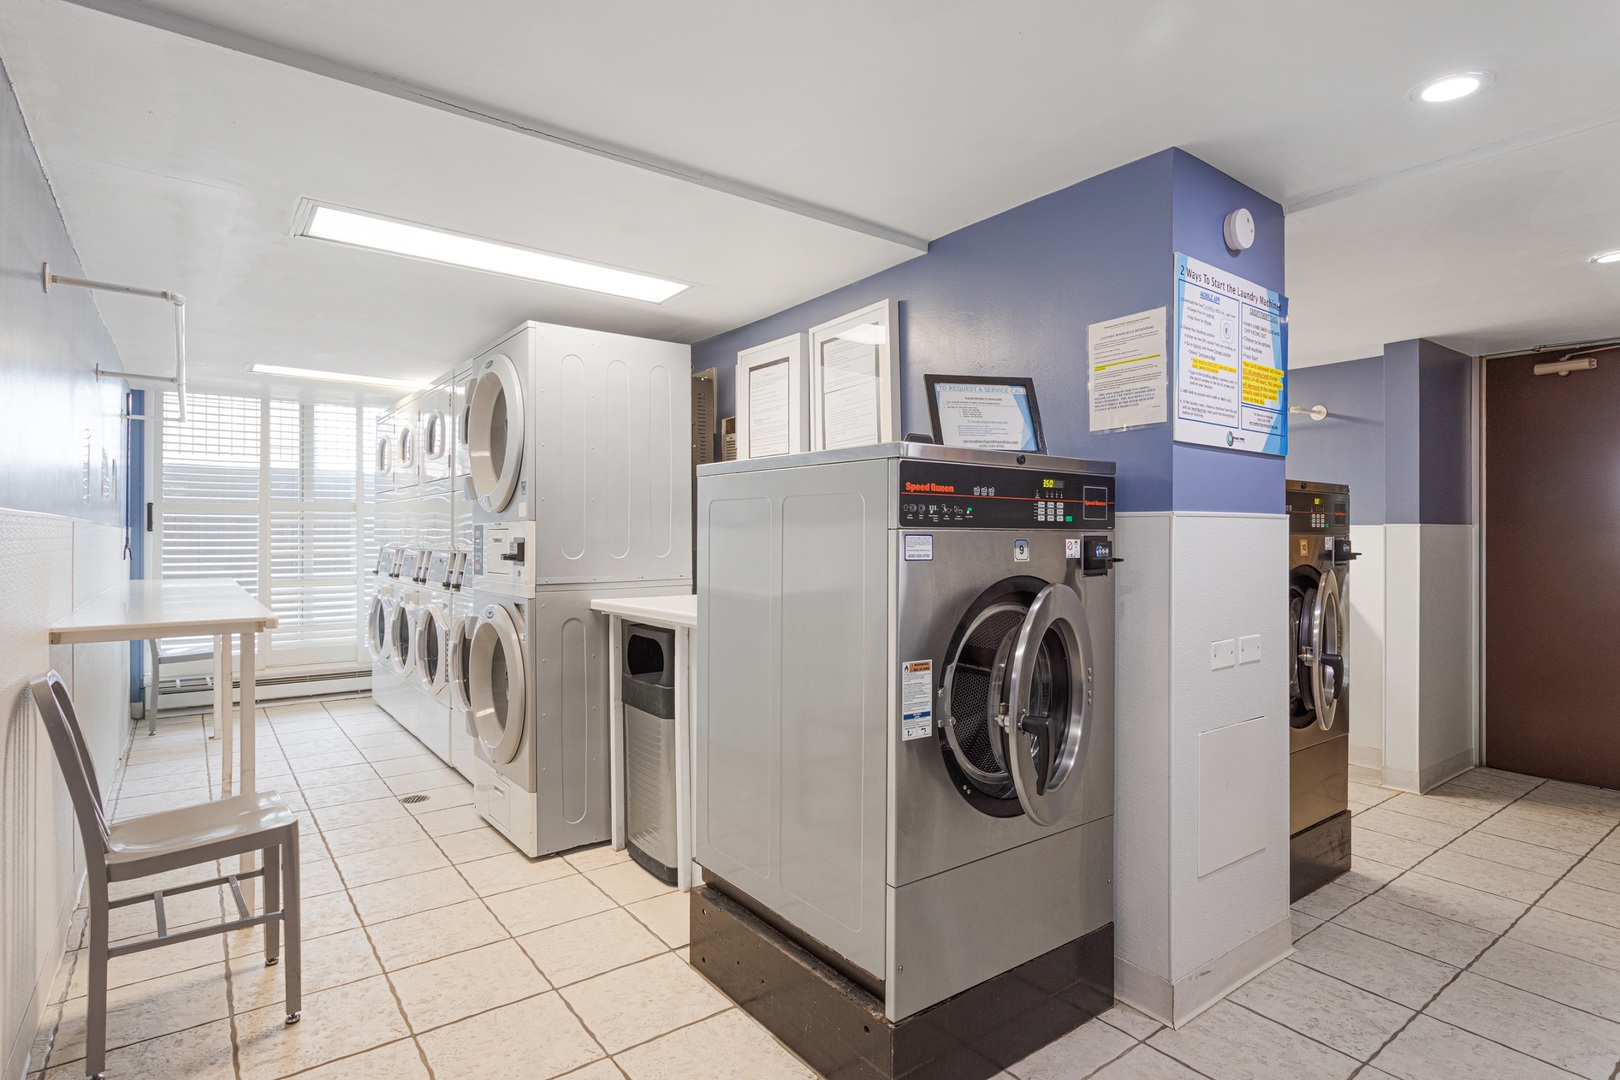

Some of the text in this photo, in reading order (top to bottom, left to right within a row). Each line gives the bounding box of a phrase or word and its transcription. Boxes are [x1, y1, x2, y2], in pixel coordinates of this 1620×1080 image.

[1180, 264, 1185, 276] 2
[1186, 267, 1202, 282] Ways
[1203, 274, 1210, 285] To
[1211, 277, 1226, 291] Start
[1226, 284, 1236, 295] the
[1237, 287, 1258, 304] Laundry
[905, 481, 955, 493] Speed Queen
[1019, 544, 1025, 555] 9
